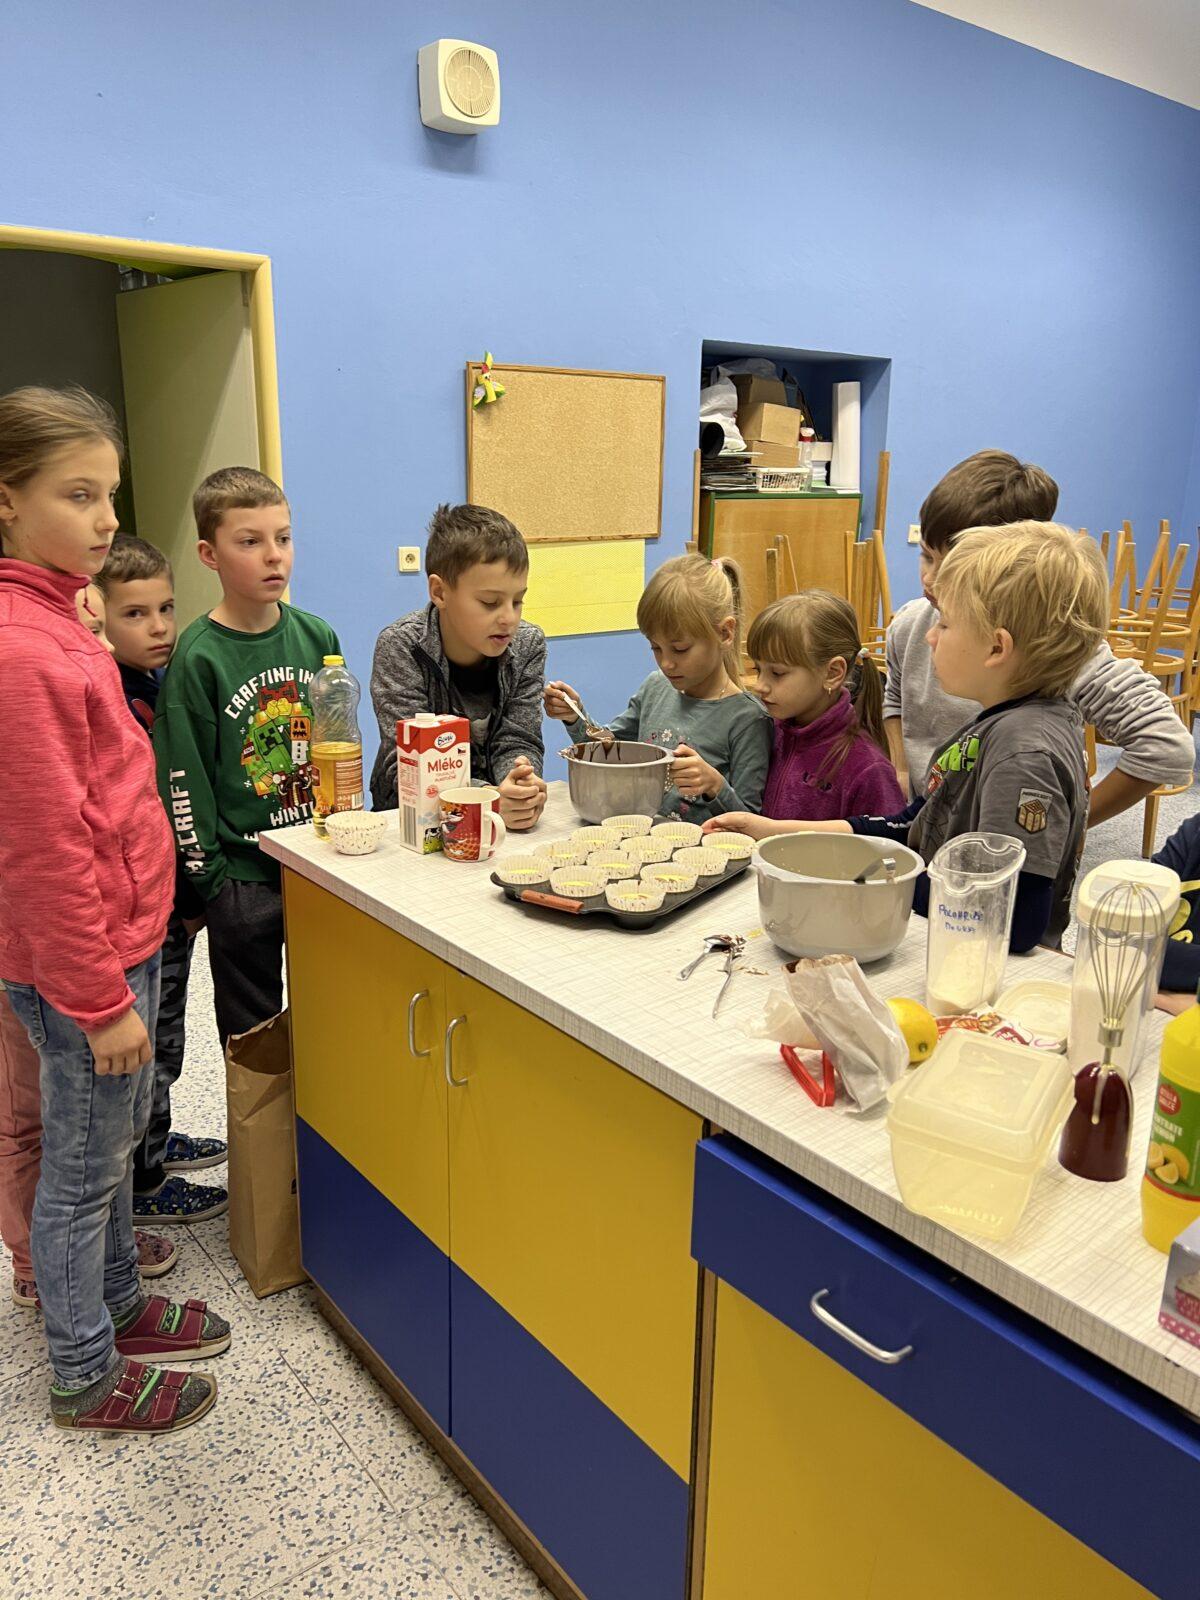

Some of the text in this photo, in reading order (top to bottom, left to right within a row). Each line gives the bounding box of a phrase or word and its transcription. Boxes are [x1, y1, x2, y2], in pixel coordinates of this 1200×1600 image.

[224, 667, 314, 720] CRAFTING IN
[427, 757, 463, 774] Mléko
